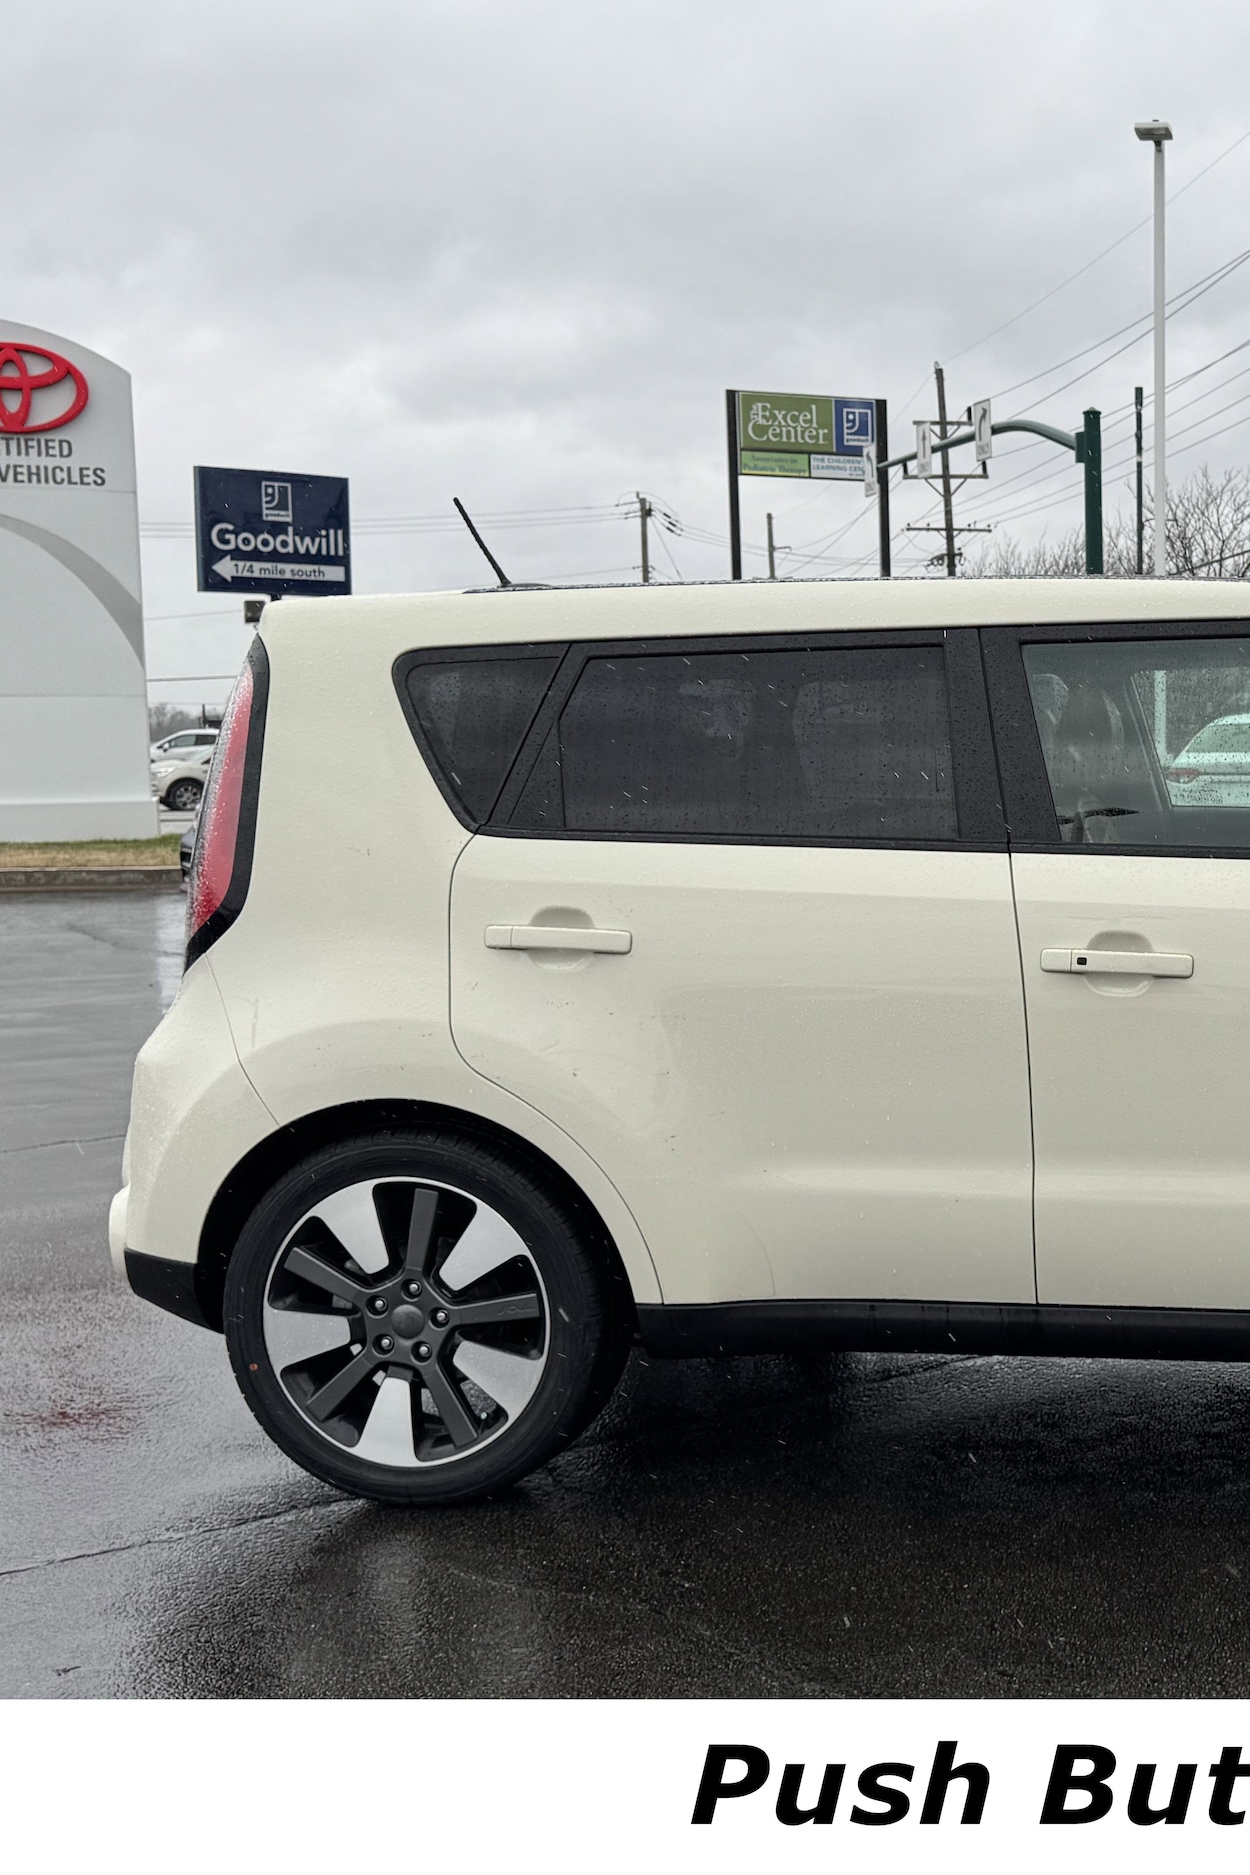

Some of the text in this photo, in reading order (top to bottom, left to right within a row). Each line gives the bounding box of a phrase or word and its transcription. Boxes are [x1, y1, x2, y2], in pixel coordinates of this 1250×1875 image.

[756, 402, 818, 428] Excel
[747, 419, 829, 445] Center
[0, 464, 106, 487] VEHICLES
[210, 522, 344, 557] Goodwill
[233, 563, 326, 579] 1/4 mile south
